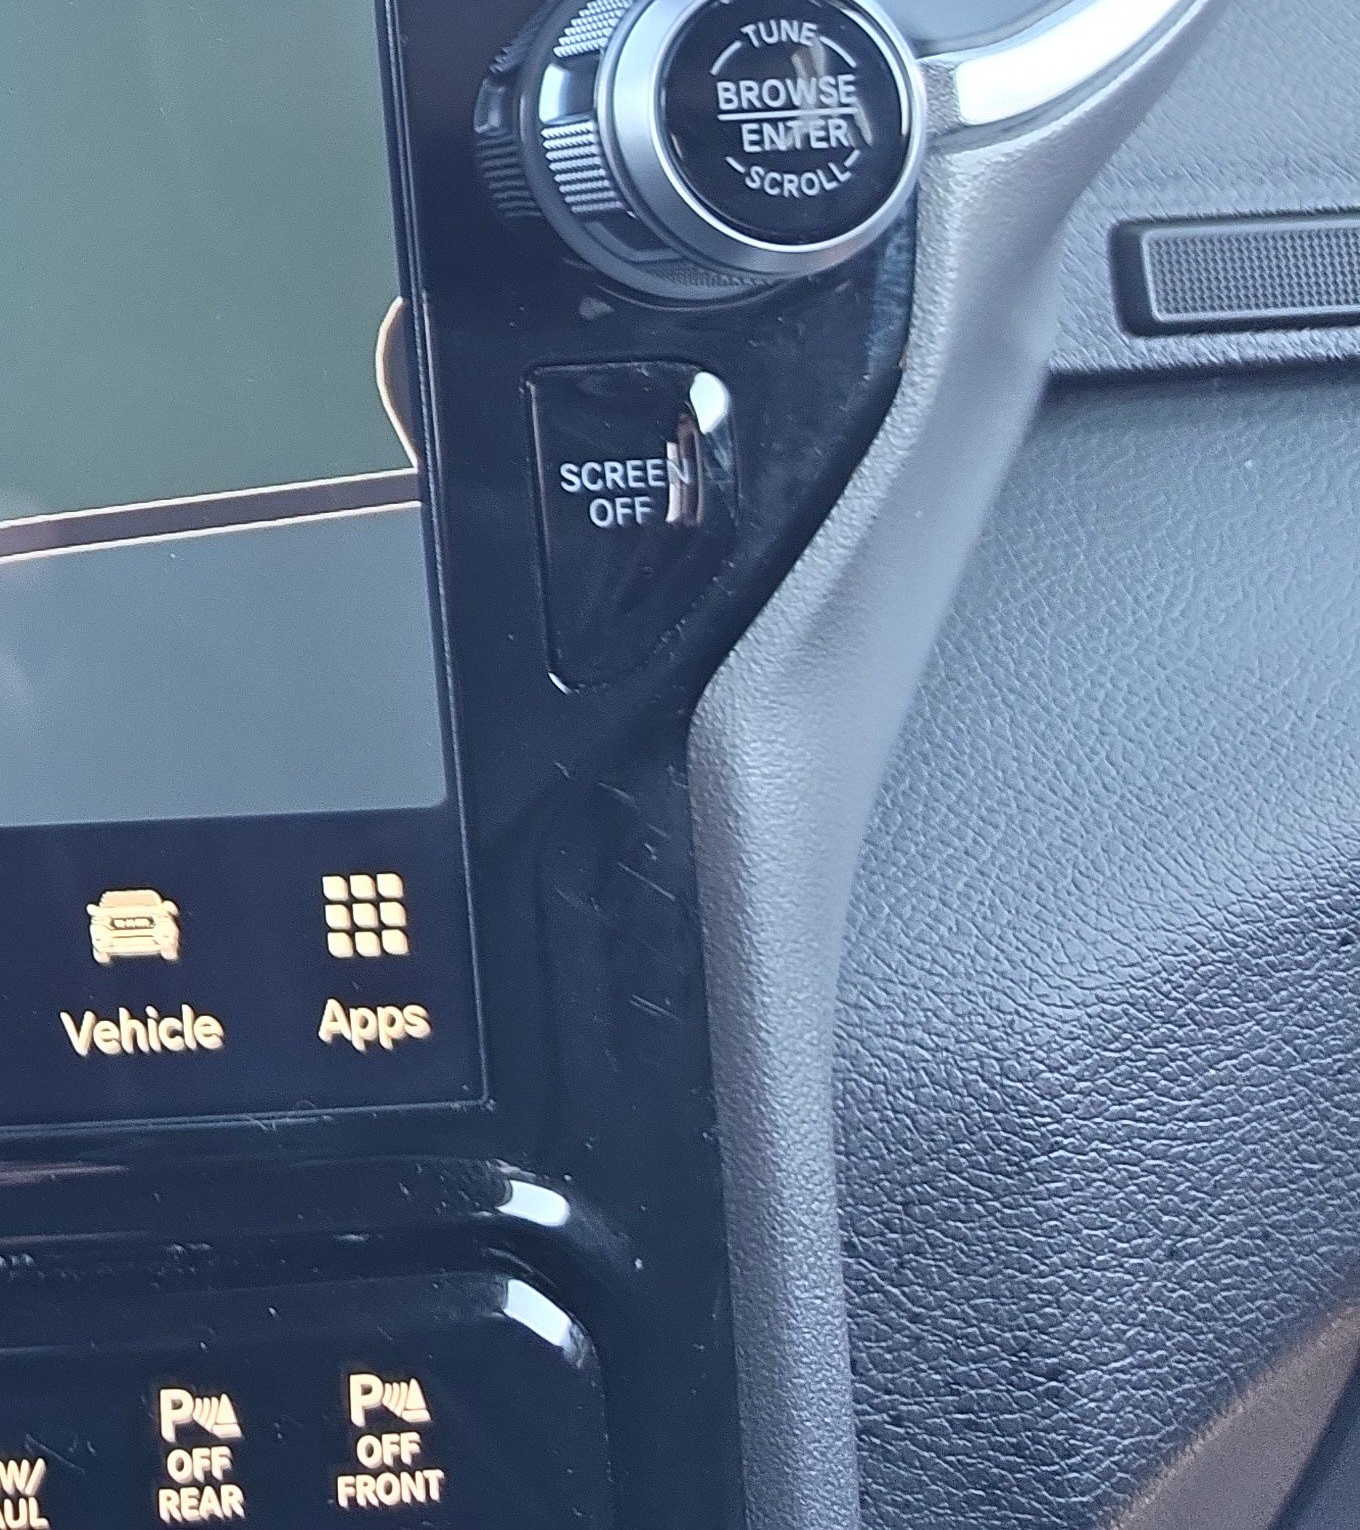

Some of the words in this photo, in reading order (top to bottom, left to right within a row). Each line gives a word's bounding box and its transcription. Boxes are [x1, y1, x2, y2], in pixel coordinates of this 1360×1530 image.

[740, 19, 818, 48] TUNE
[716, 74, 858, 111] BROWSE
[740, 118, 850, 153] ENTER
[744, 161, 853, 198] SCROLL
[560, 458, 692, 493] SCREEN
[589, 495, 654, 528] OFF
[59, 1003, 225, 1057] Vehicle
[317, 998, 433, 1053] Apps
[166, 1446, 234, 1484] OFF
[356, 1432, 422, 1470] OFF
[157, 1483, 246, 1525] REAR
[337, 1468, 446, 1511] FRONT
